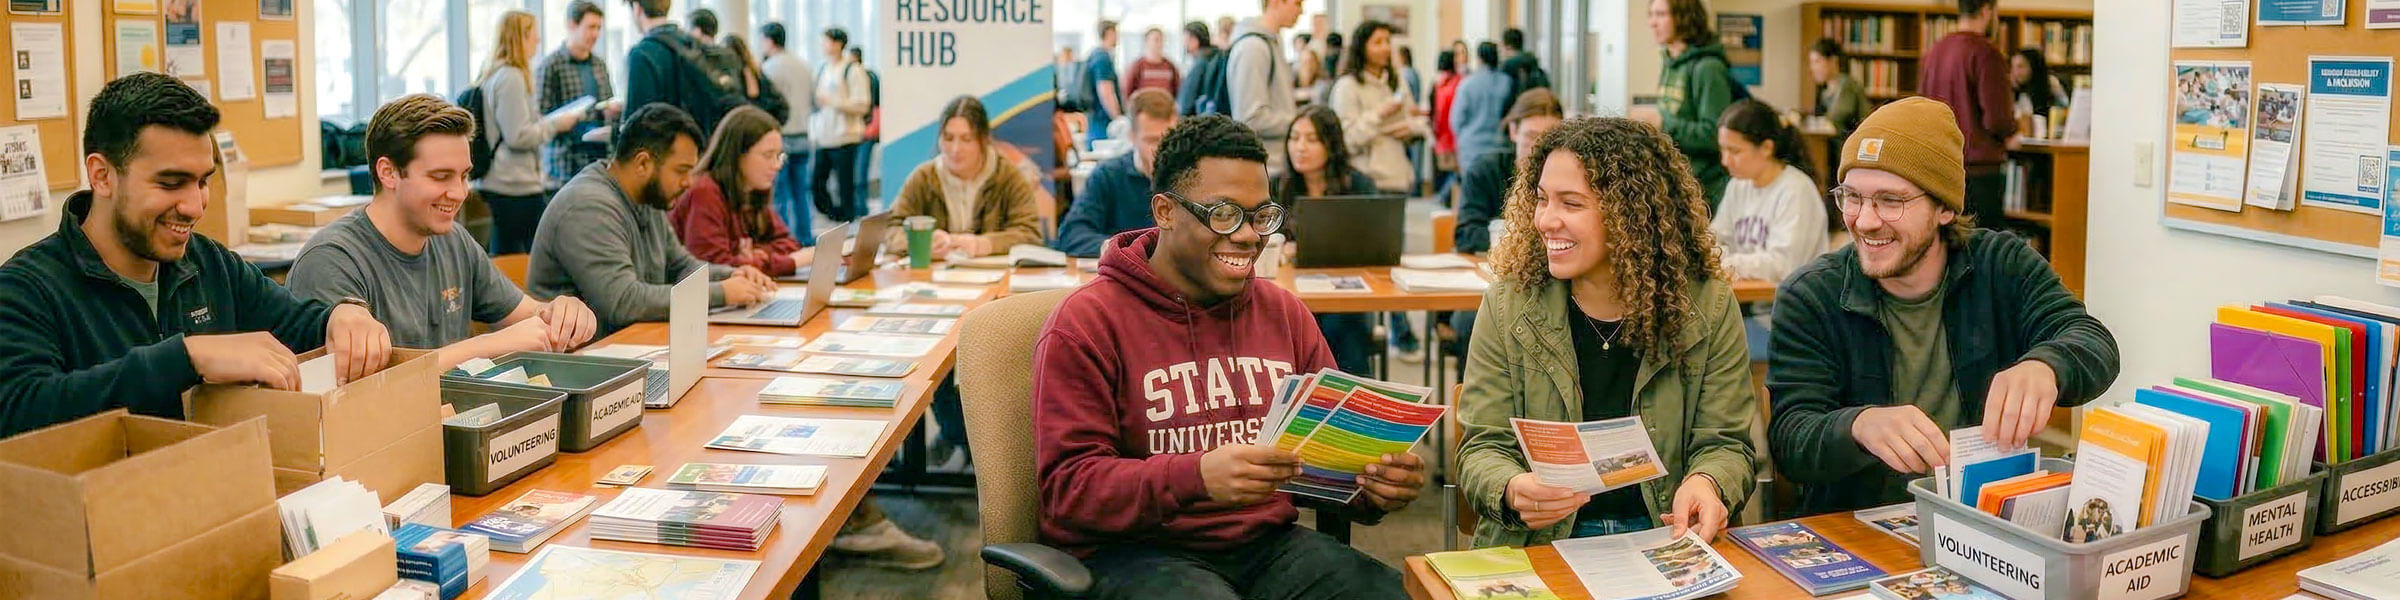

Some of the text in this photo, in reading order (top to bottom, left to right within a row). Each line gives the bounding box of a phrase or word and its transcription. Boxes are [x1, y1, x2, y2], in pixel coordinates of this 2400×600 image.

[897, 0, 1044, 23] RESOURCE
[897, 31, 956, 66] HUB
[490, 428, 556, 465] VOLUNTEERING
[1148, 416, 1267, 455] UNIVERS
[2248, 502, 2297, 528] MENTAL
[2248, 522, 2294, 547] HEALTH
[1938, 532, 2040, 590] VOLUNTEERING
[2104, 545, 2180, 578] ACADEMIC
[2125, 575, 2152, 594] AID
